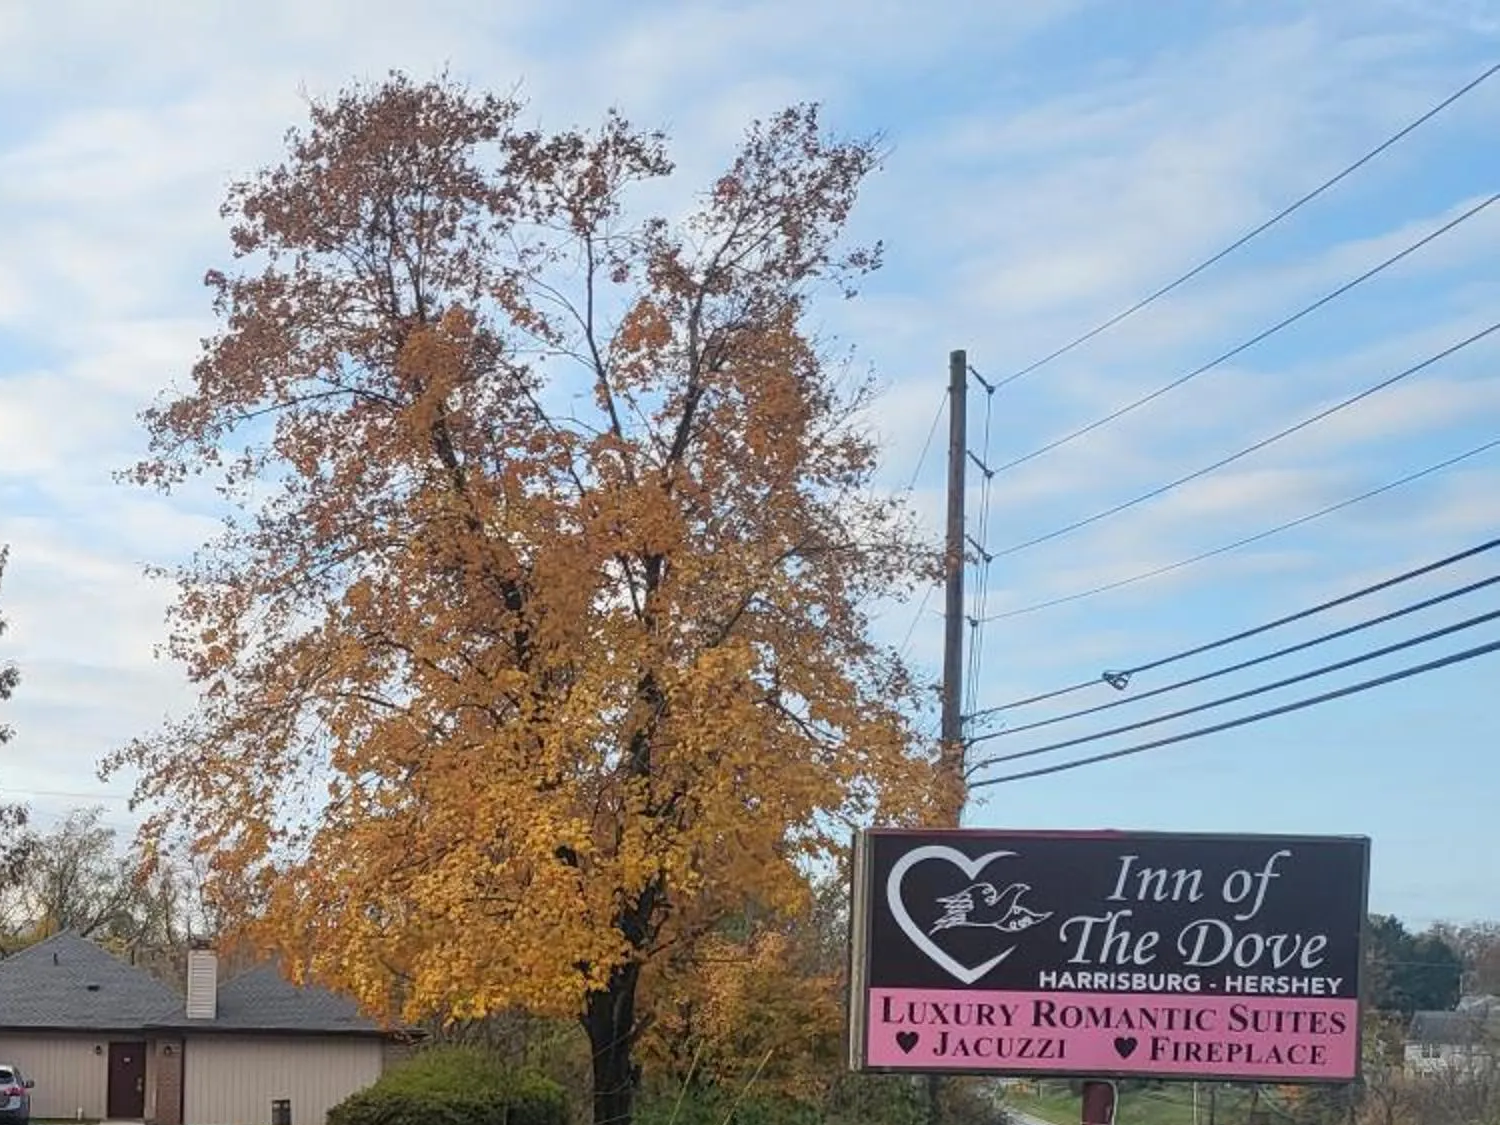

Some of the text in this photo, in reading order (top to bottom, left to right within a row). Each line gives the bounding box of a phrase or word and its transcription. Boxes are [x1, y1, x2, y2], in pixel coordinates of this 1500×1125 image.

[1106, 849, 1292, 921] Inn of
[1059, 909, 1328, 969] The Dove
[1039, 970, 1201, 993] HARRISBURG
[1225, 974, 1343, 995] HERSHEY
[881, 996, 1347, 1035] LUXURY ROMANTIC SUITES
[932, 1031, 1066, 1059] JACUZZI
[1150, 1035, 1328, 1065] FIREPLACE
